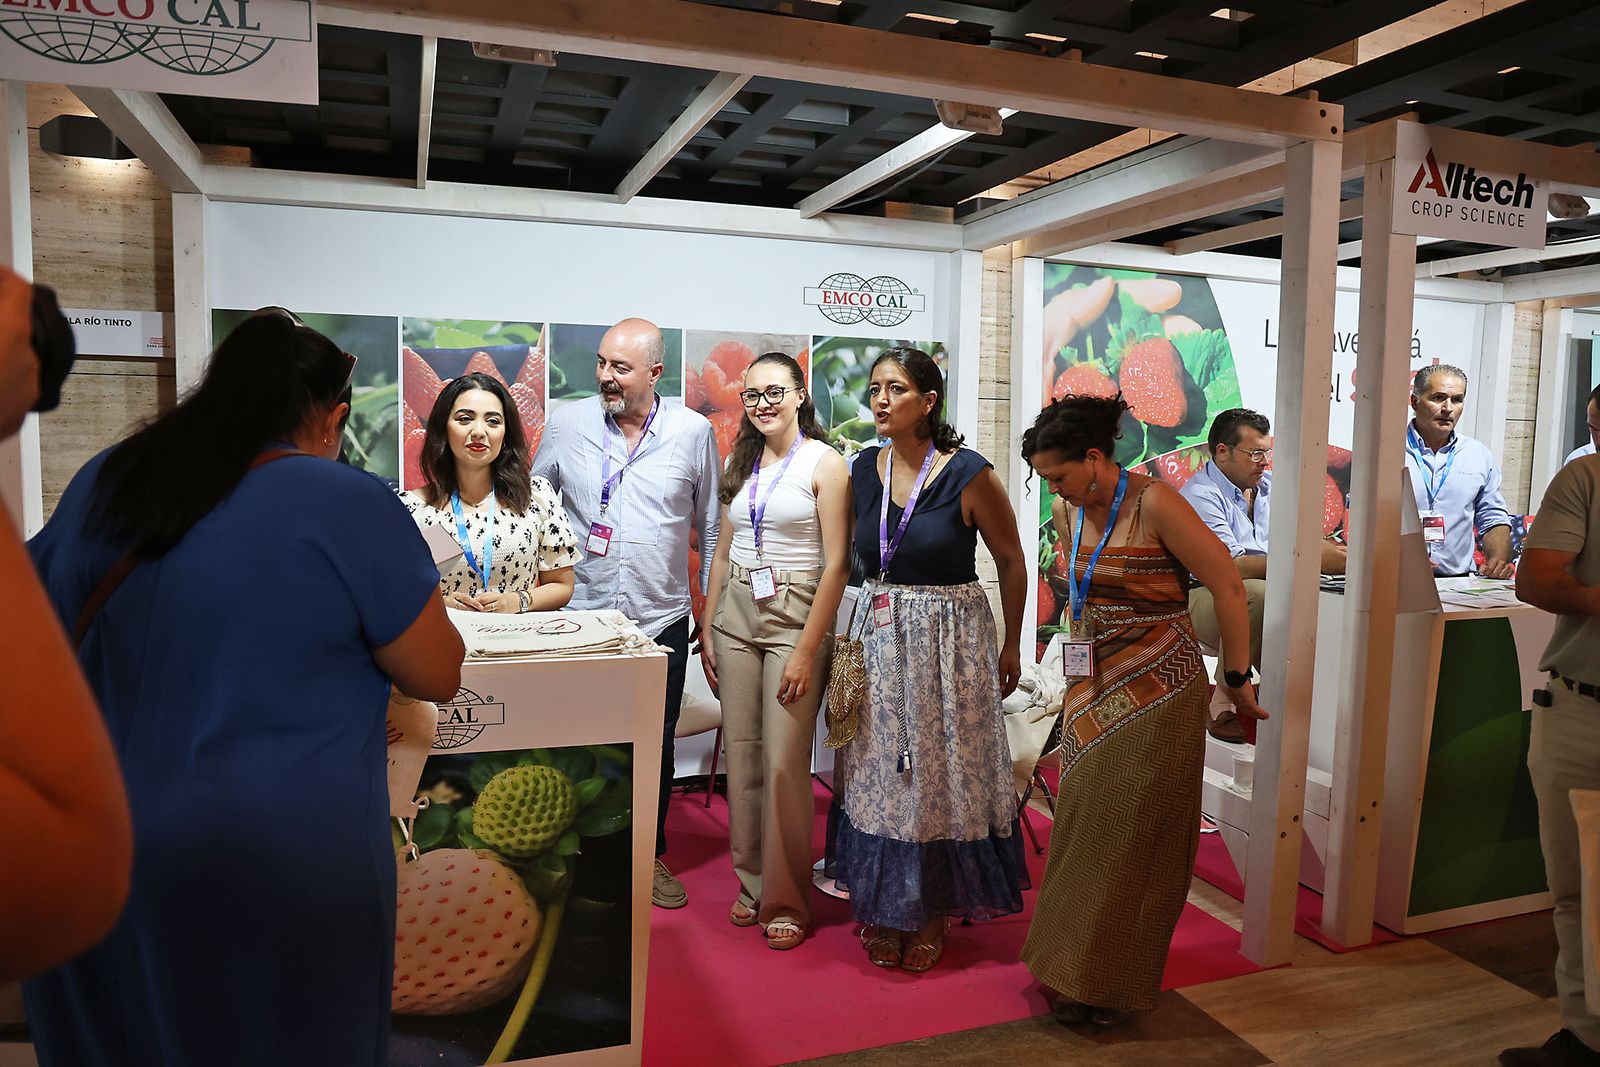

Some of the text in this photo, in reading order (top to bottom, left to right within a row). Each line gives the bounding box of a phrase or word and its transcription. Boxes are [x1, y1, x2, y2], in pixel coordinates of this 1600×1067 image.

[167, 0, 261, 31] CAL
[1407, 147, 1535, 209] Alltech
[1411, 200, 1525, 228] CROP SCIENCE
[822, 290, 908, 309] EMCO CAL
[84, 316, 101, 326] RÍO
[103, 318, 132, 327] TINTO
